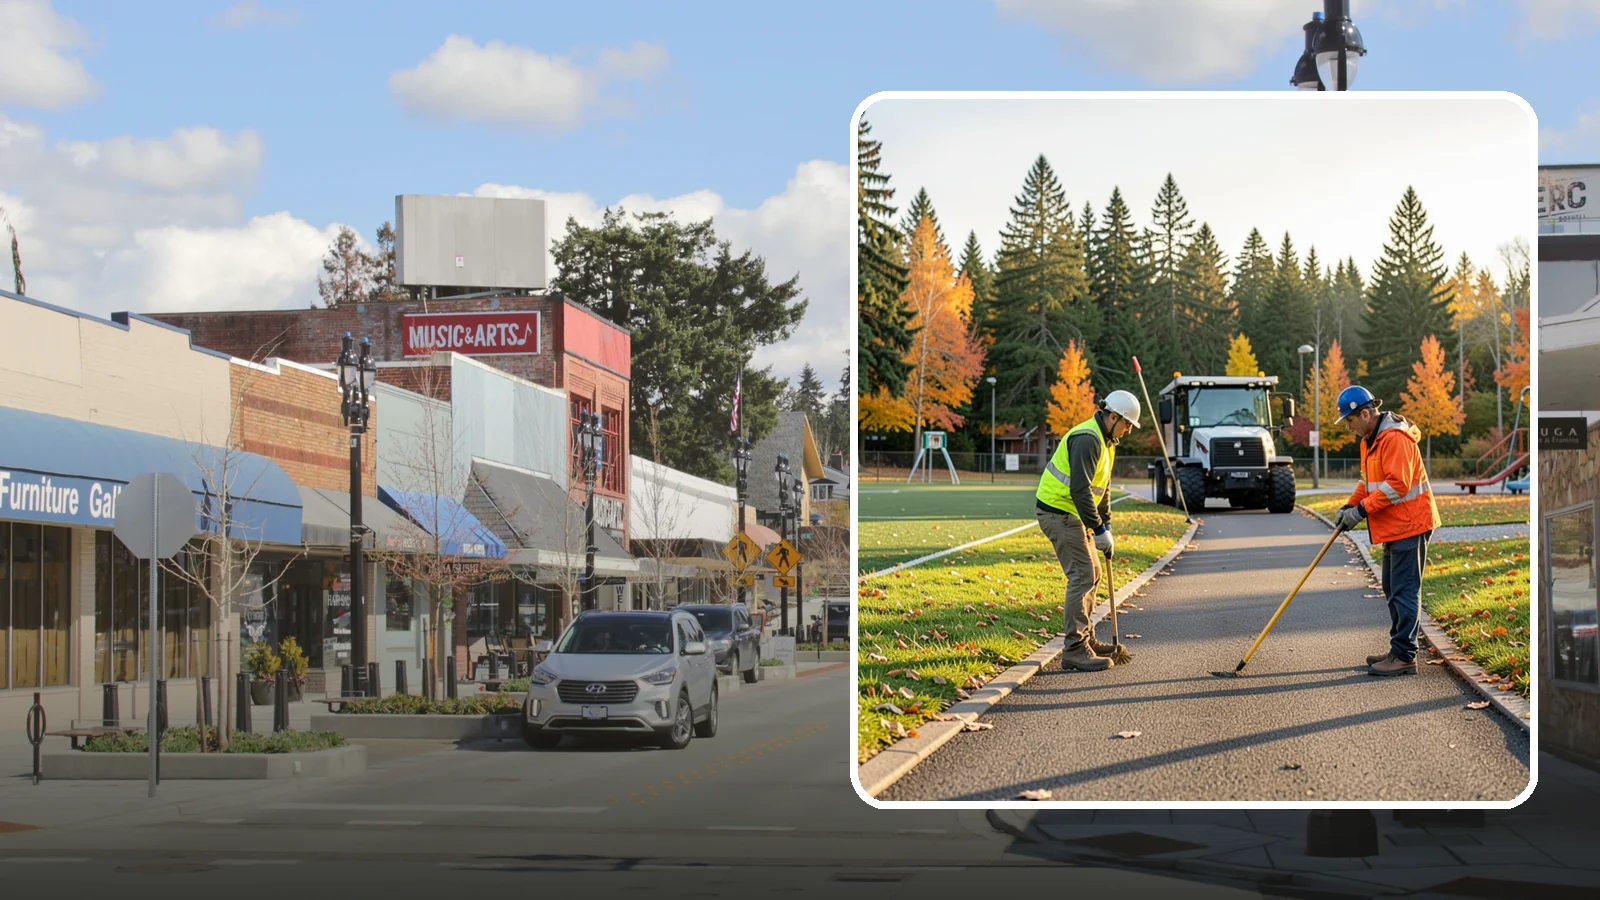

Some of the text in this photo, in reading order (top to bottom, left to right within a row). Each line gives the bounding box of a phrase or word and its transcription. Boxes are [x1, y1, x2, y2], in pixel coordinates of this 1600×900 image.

[1551, 436, 1580, 445] Framing
[0, 471, 122, 519] Furniture Gal
[453, 563, 479, 574] SUSHI
